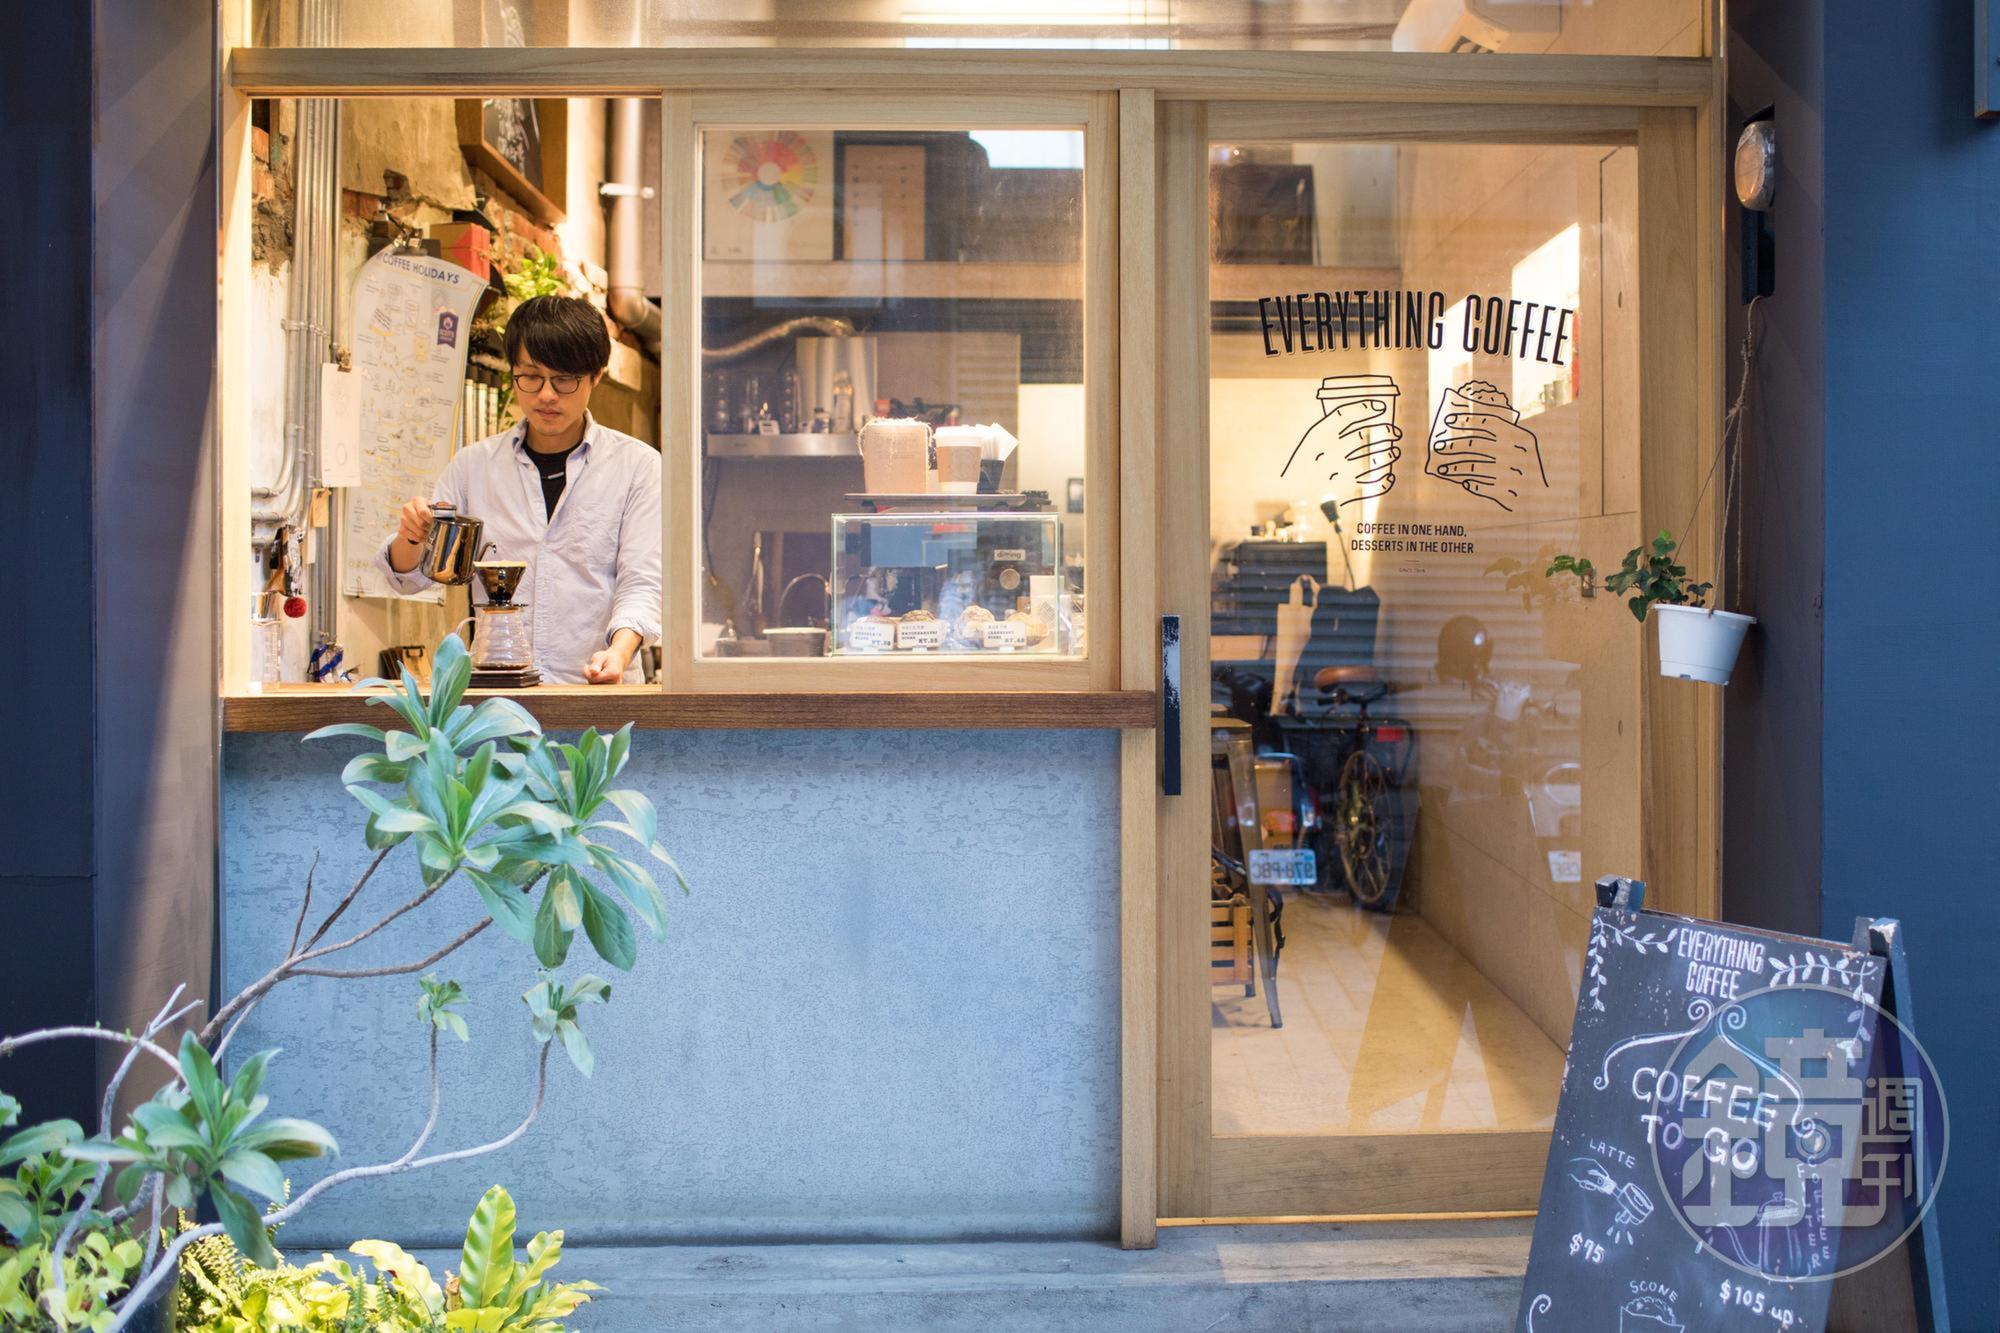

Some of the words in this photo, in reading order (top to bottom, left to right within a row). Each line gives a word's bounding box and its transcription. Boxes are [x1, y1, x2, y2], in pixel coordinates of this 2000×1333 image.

[383, 253, 410, 271] COFFEE
[413, 264, 460, 284] HOLIDAYS
[1258, 290, 1445, 357] EVERYTHING
[1462, 294, 1575, 366] COFFEE
[1351, 540, 1403, 552] DESSERTS
[1406, 541, 1417, 552] IN
[1419, 542, 1438, 553] THE
[1441, 542, 1474, 554] OTHER
[1357, 523, 1395, 535] COFFEE
[1398, 523, 1409, 535] IN
[1411, 524, 1432, 536] ONE
[1434, 526, 1467, 537] HAND,
[1677, 928, 1764, 974] EVERYTHING
[1685, 961, 1741, 1000] COFFEE
[1632, 1066, 1779, 1132] COFFEE
[1589, 1138, 1636, 1169] LATTE
[1640, 1114, 1683, 1149] TO
[1703, 1126, 1758, 1172] GO
[1796, 1163, 1821, 1269] FILTER
[1807, 1155, 1831, 1260] COFFEE
[1569, 1232, 1604, 1264] $75
[1629, 1280, 1678, 1303] SCONE
[1719, 1279, 1765, 1315] $105
